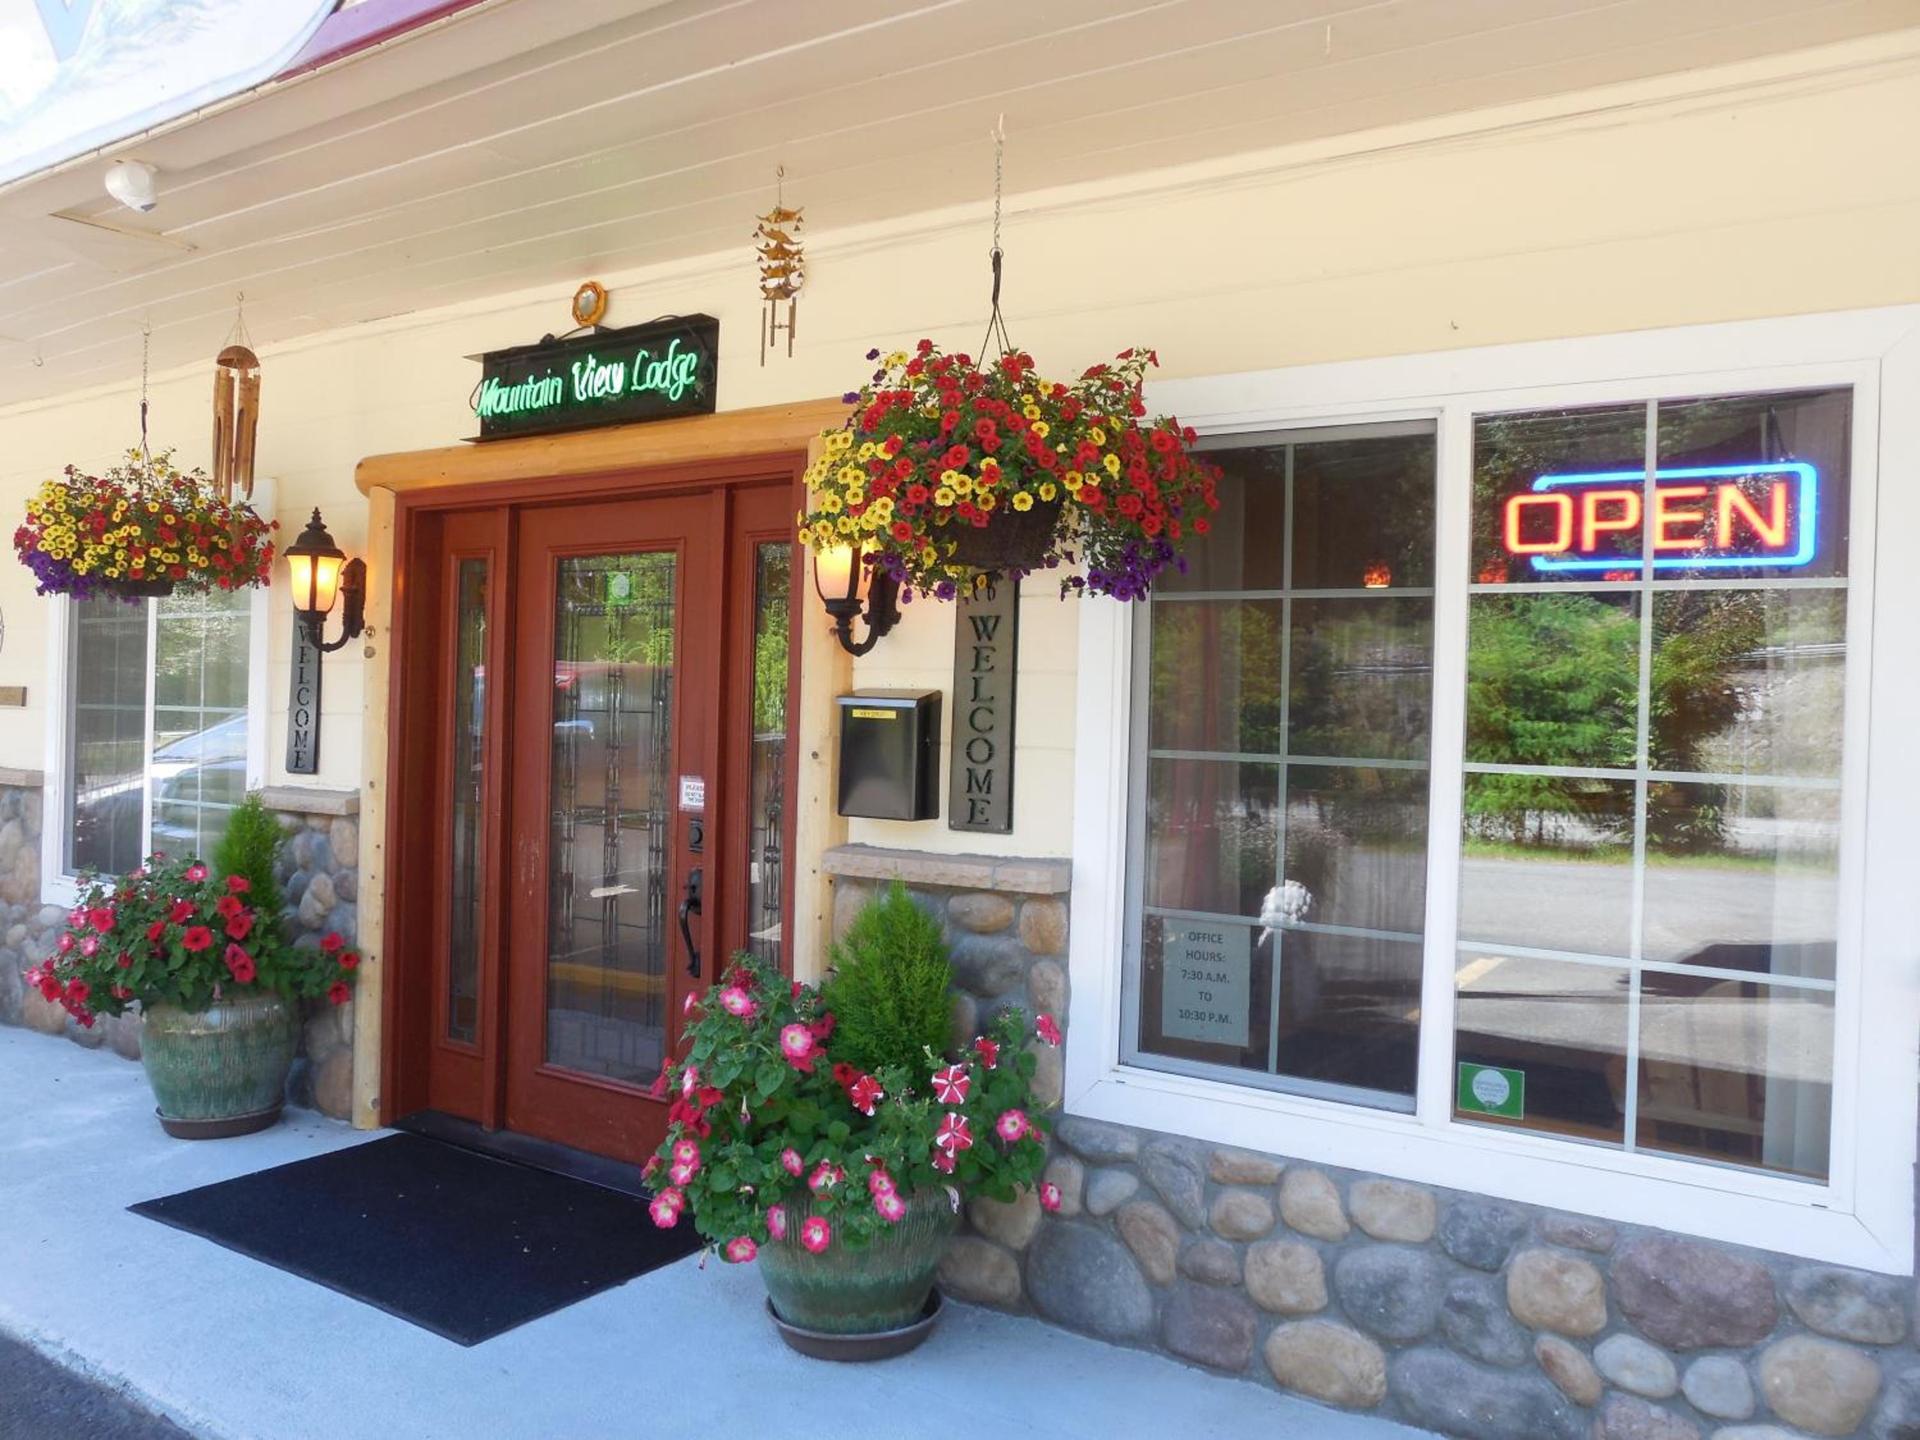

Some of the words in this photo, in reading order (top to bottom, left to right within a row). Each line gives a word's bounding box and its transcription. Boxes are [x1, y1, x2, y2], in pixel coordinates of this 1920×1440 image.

[476, 368, 563, 417] Mountain
[571, 353, 625, 401] View
[631, 337, 698, 402] Lodge
[1503, 481, 1789, 555] OPEN
[965, 614, 1001, 826] WELCOME
[1188, 931, 1224, 945] OFFICE
[1185, 949, 1226, 963] HOURS:
[1181, 969, 1203, 981] 7:30
[1205, 971, 1230, 984] A.M.
[1198, 991, 1212, 1002] TO
[1178, 1008, 1206, 1022] 10:30
[1208, 1010, 1232, 1025] P.M.
